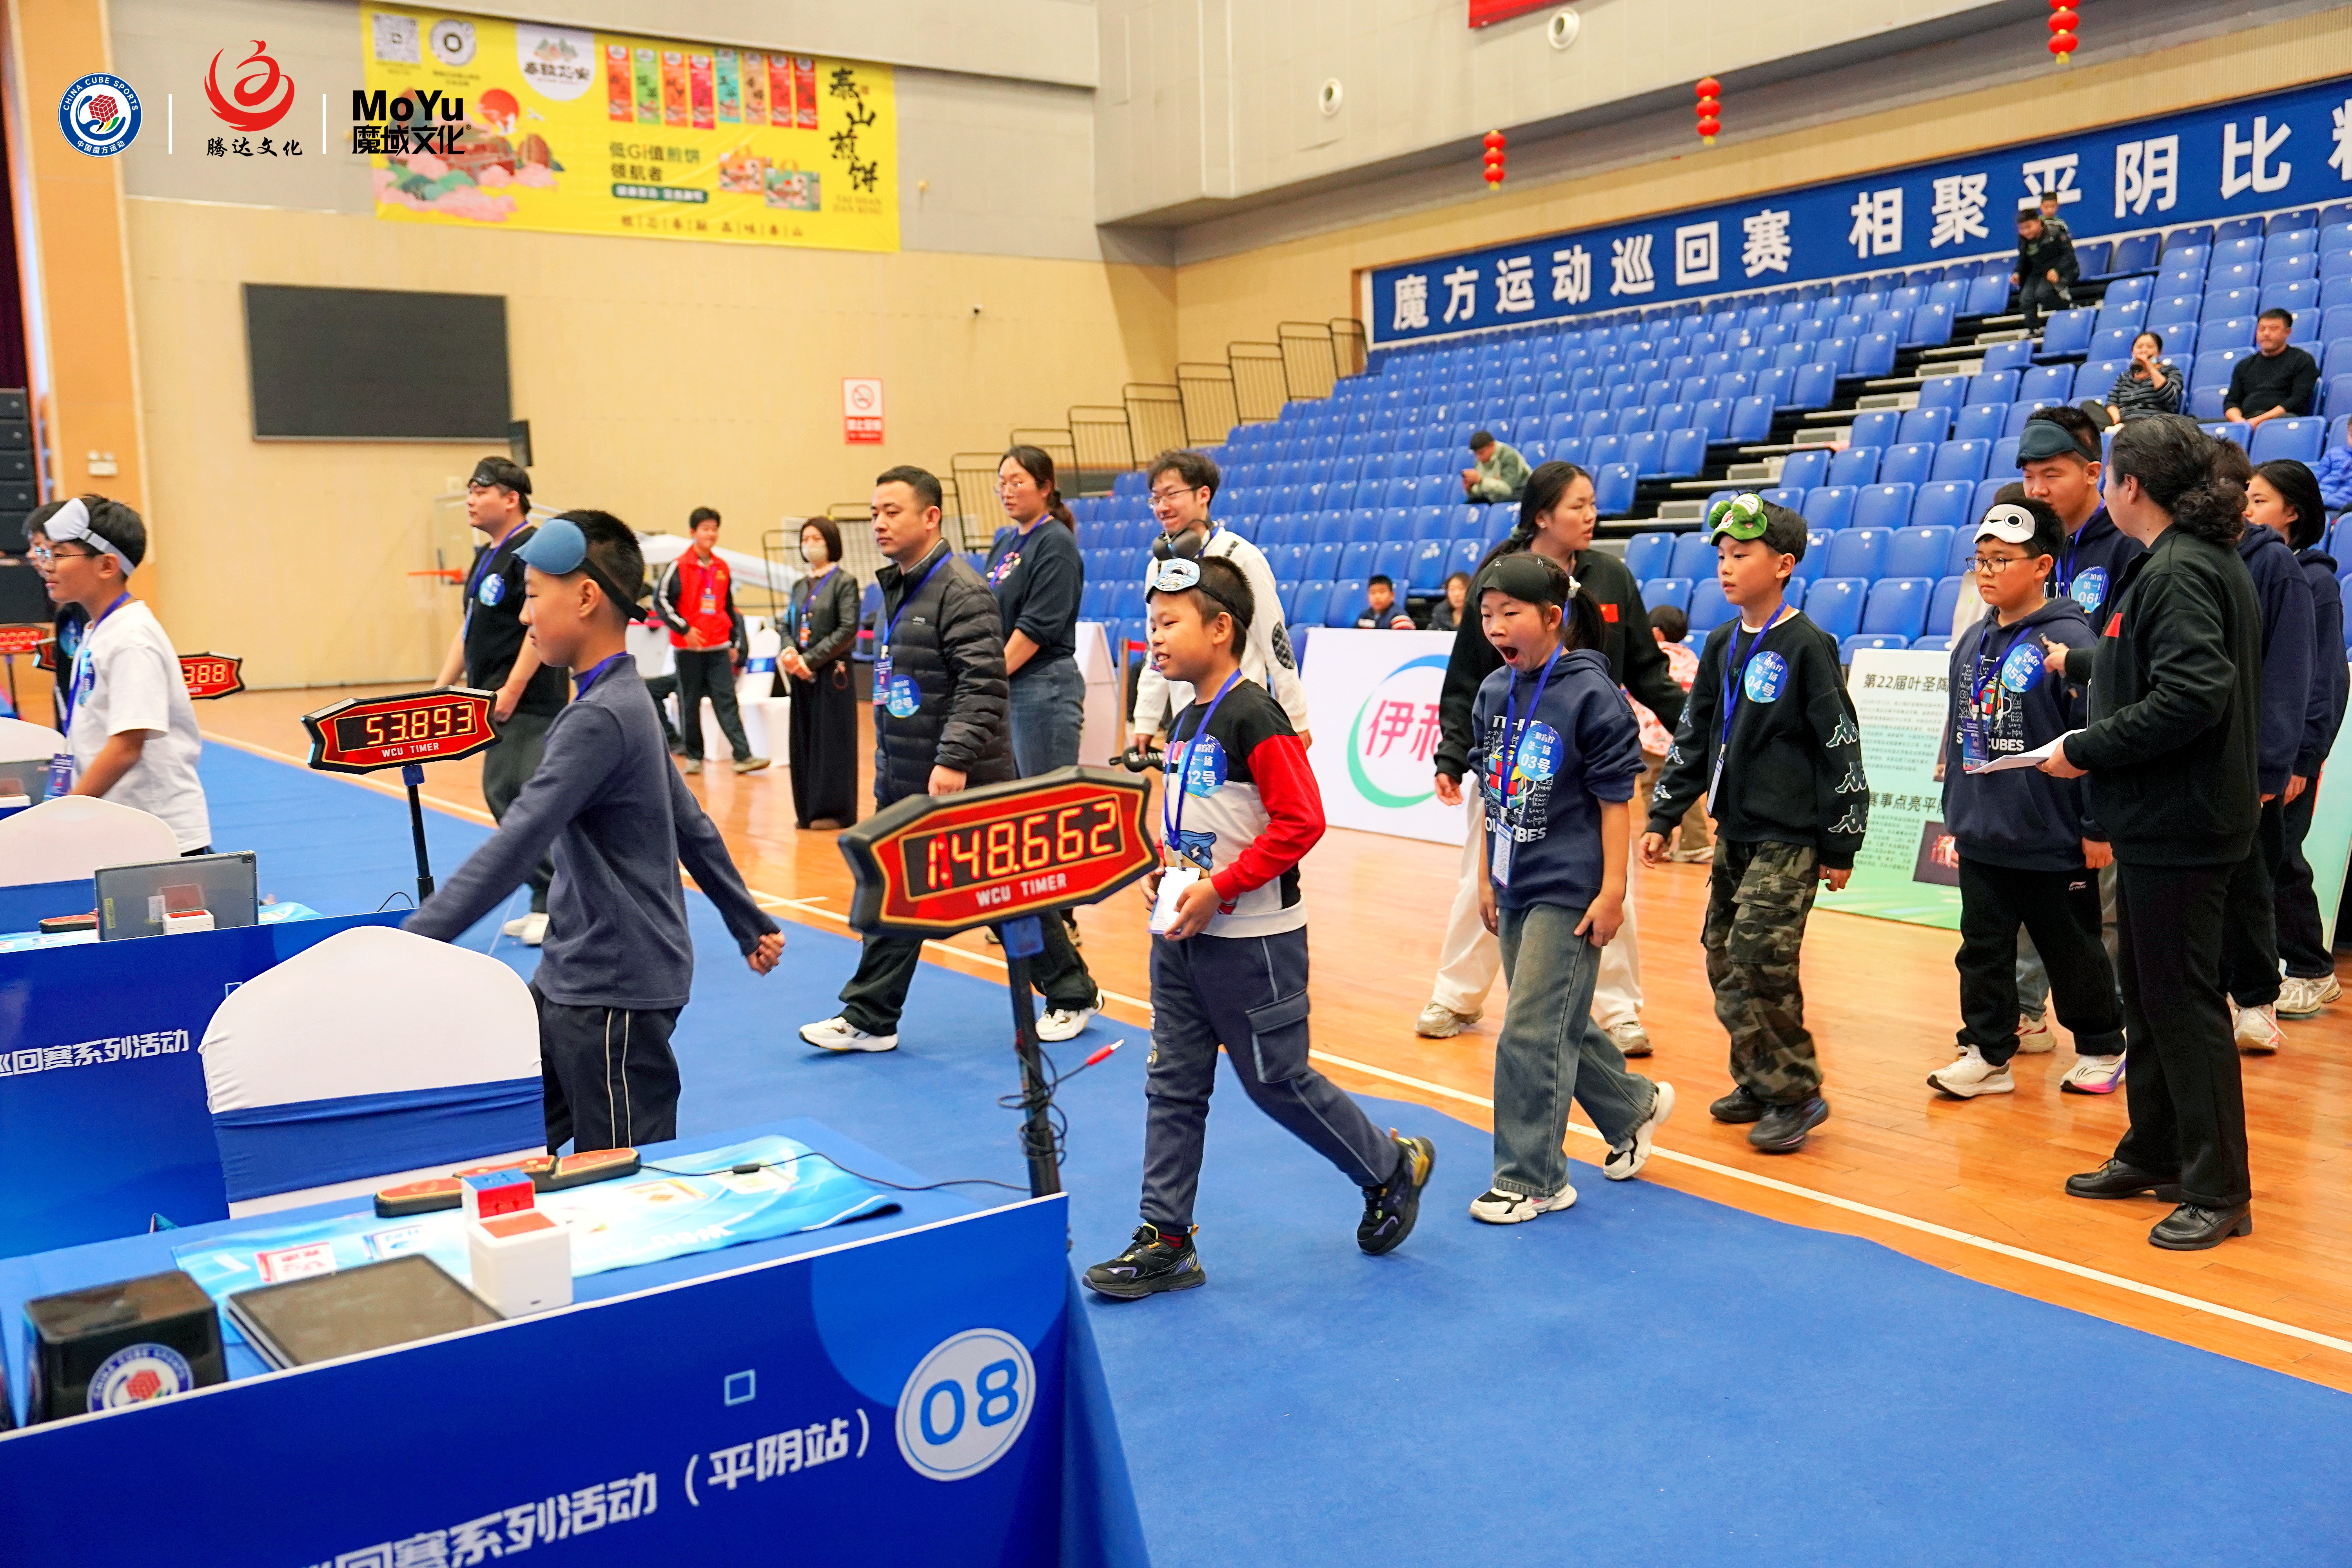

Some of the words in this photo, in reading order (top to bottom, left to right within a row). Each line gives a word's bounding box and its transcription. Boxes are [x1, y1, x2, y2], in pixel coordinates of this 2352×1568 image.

[1392, 209, 1792, 332] 魔方运动巡回赛
[1748, 675, 1776, 697] 04号
[1863, 673, 1949, 692] 第22届叶圣陶
[2005, 663, 2028, 687] 05号
[366, 704, 473, 746] 53.893
[381, 747, 404, 758] WCU
[410, 742, 439, 754] TIMER
[1527, 740, 1552, 756] 第一场
[1521, 753, 1551, 773] 03号
[927, 800, 1118, 890] 1:48.662
[975, 887, 1012, 907] WCU
[1022, 873, 1067, 897] TIMER
[920, 1357, 1019, 1446] 08
